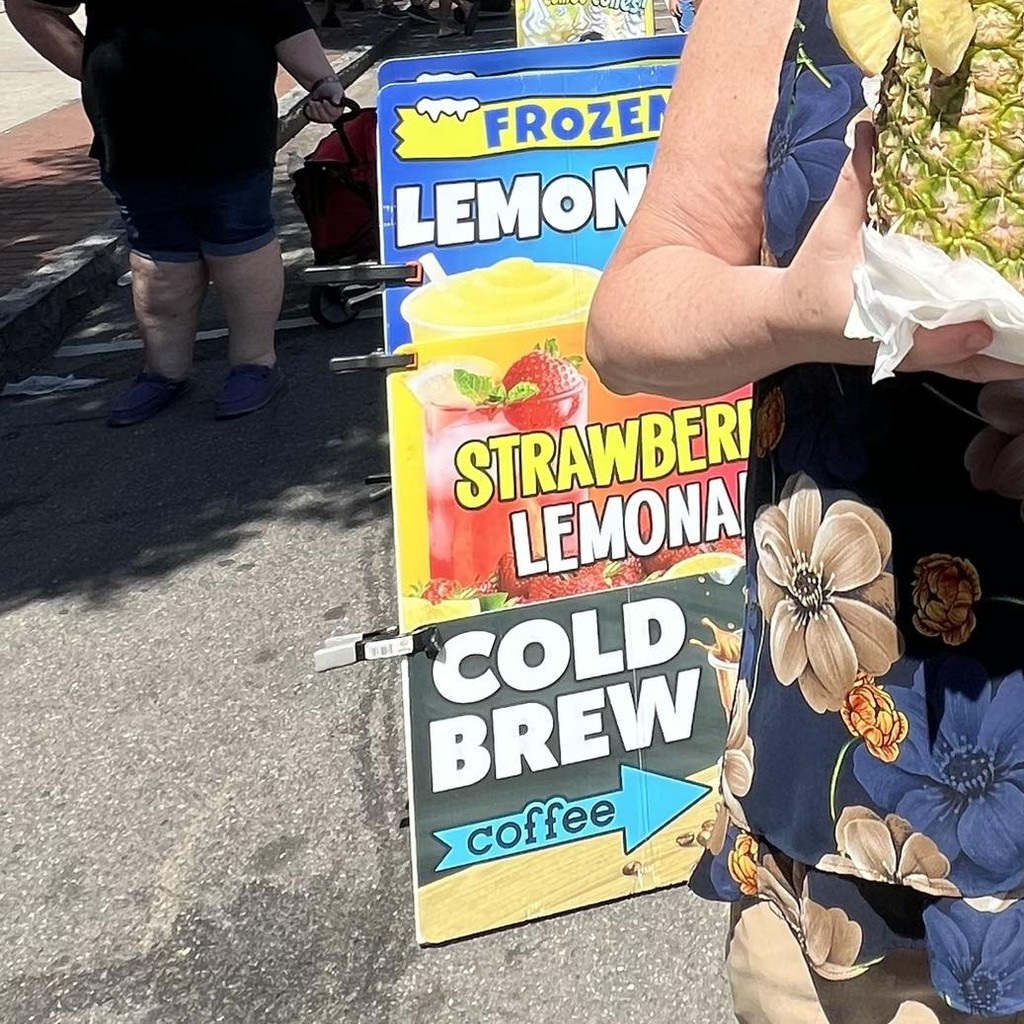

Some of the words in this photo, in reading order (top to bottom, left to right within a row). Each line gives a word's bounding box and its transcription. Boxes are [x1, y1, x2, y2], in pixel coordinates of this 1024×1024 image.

[395, 166, 649, 248] LEMON
[510, 471, 747, 580] LEMONA
[431, 596, 686, 704] COLD
[430, 668, 700, 793] BREW
[467, 799, 615, 855] coffee
